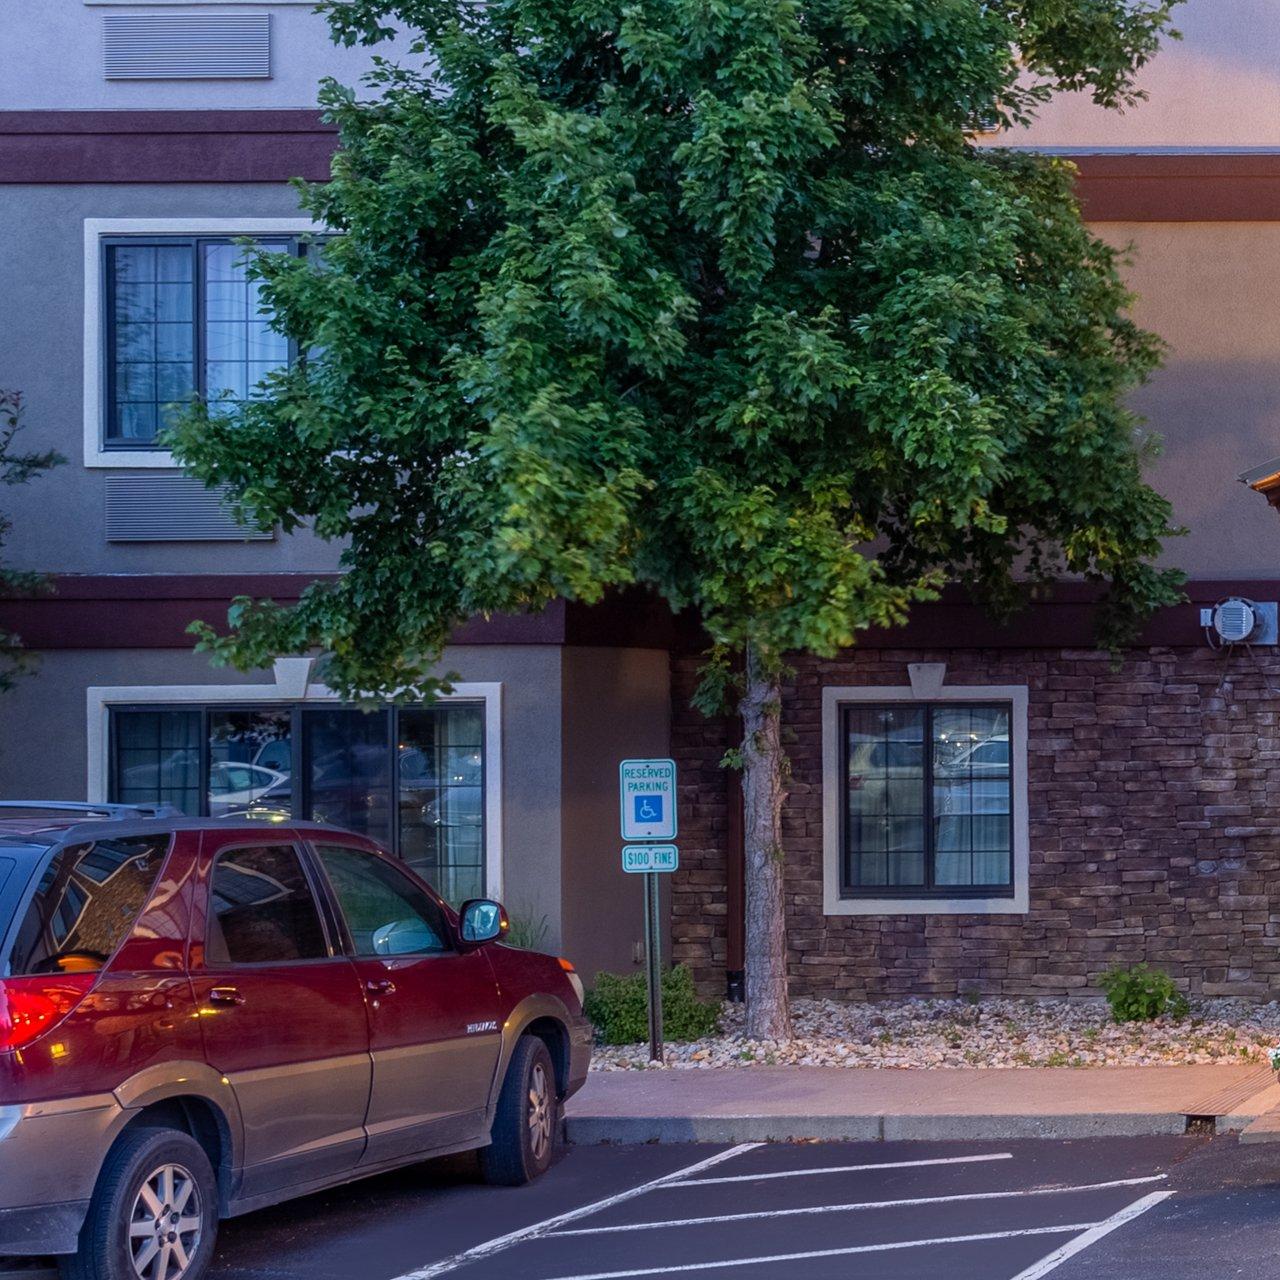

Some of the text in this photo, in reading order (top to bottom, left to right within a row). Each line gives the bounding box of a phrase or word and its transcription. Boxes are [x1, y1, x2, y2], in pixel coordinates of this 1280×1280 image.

[624, 768, 671, 779] RESERVED
[627, 782, 669, 792] PARKING
[628, 852, 673, 866] $100 FINE
